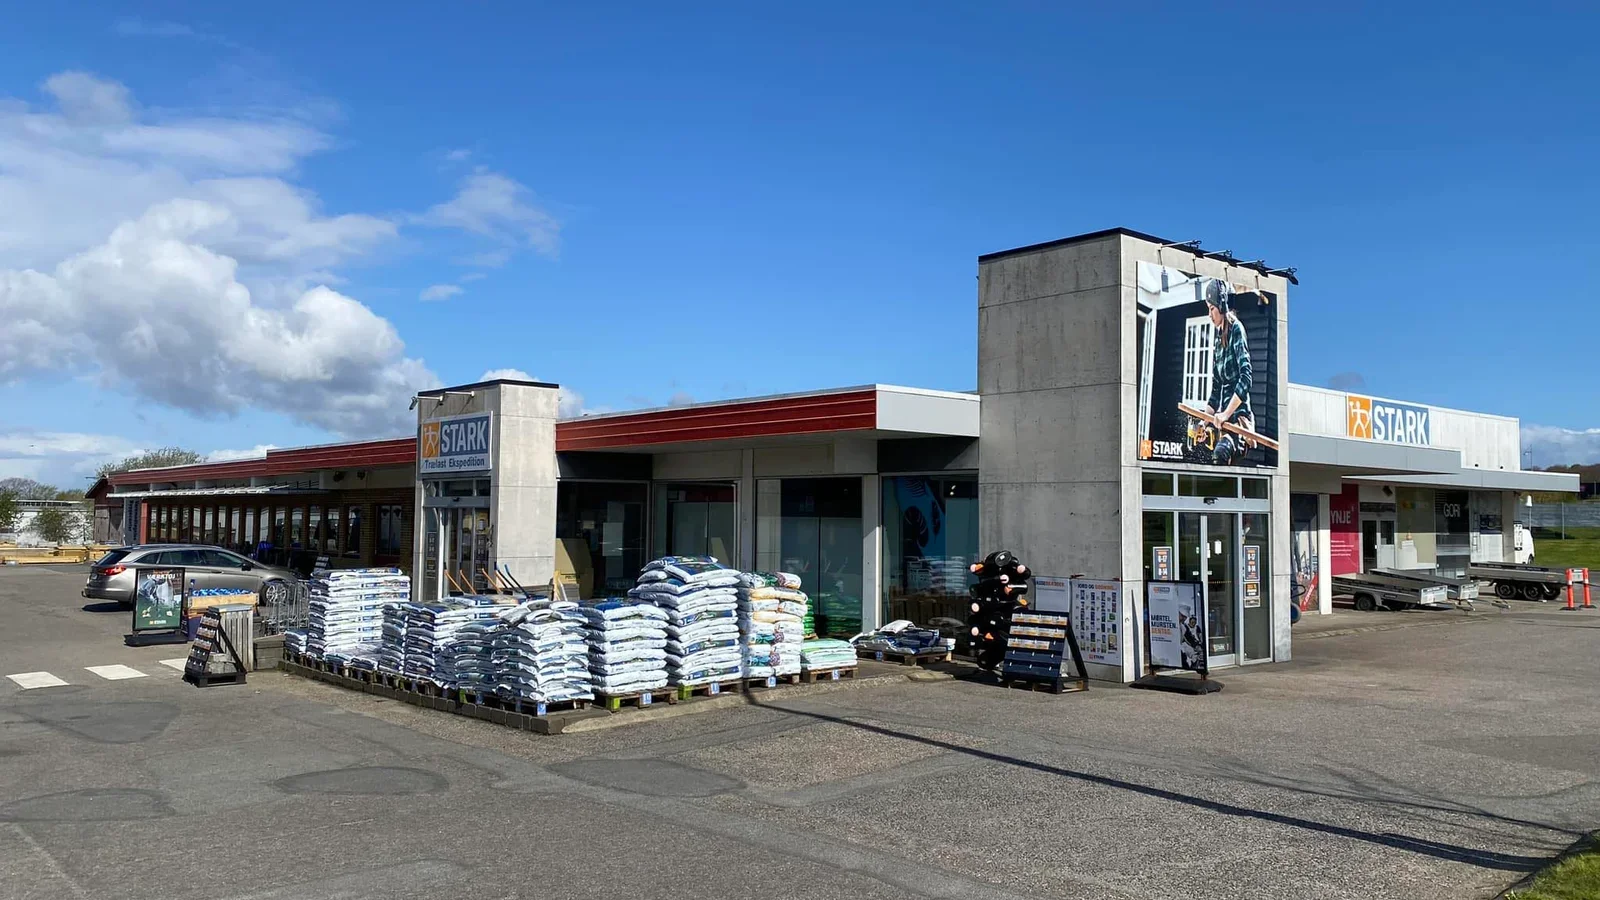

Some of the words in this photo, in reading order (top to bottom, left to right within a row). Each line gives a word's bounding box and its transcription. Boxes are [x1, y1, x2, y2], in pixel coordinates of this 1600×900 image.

[1374, 405, 1428, 445] STARK
[441, 421, 487, 453] STARK
[1152, 440, 1183, 455] STARK
[424, 459, 447, 469] Trælast
[448, 456, 485, 469] Ekspedition
